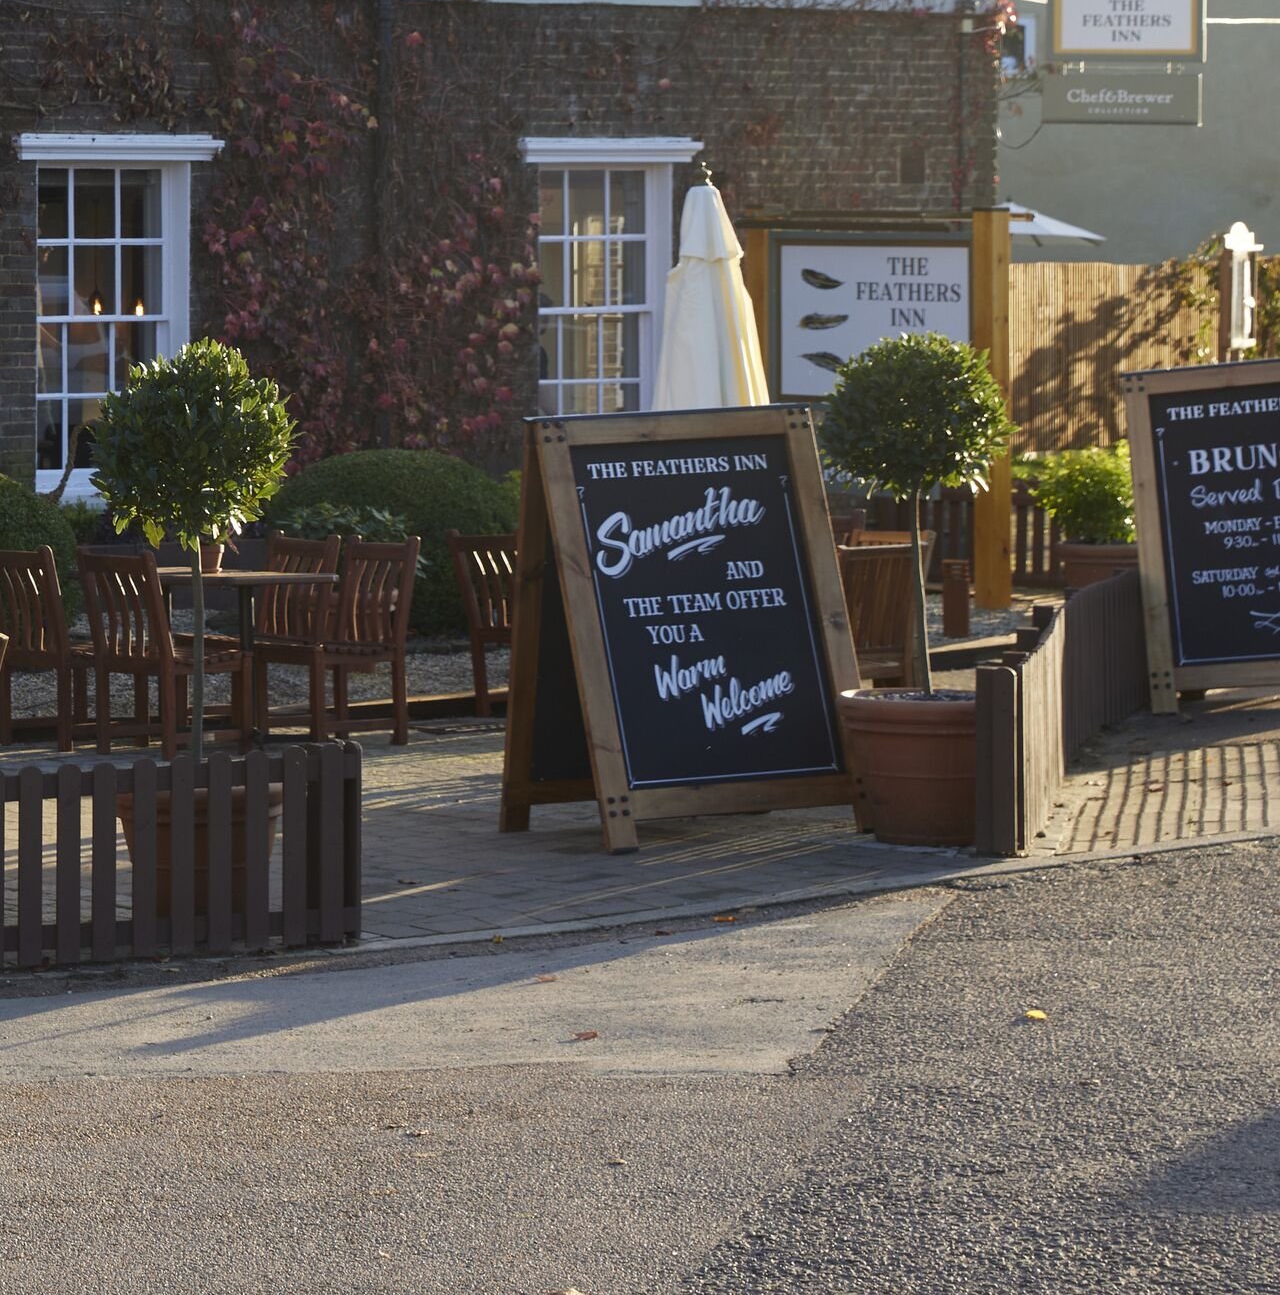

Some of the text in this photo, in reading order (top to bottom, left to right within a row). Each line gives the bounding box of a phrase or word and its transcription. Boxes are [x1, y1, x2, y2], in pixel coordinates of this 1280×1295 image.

[1109, 0, 1145, 12] THE
[1082, 14, 1171, 27] FEATHERS
[1111, 29, 1141, 42] INN
[886, 256, 929, 276] THE
[856, 281, 961, 303] FEATHERS
[890, 307, 926, 327] INN
[1167, 397, 1280, 421] THE FEATHE
[587, 453, 768, 480] THE FEATHERS INN
[1188, 443, 1280, 475] BRUN
[1190, 478, 1263, 508] Served
[596, 486, 766, 578] Samantha
[1204, 517, 1262, 534] MONDAY
[726, 560, 764, 580] AND
[1192, 566, 1259, 585] SATURDAY
[623, 588, 786, 617] THE TEAM OFFER
[646, 623, 704, 645] YOU A
[654, 654, 727, 701] Warm
[700, 671, 795, 731] Welcome
